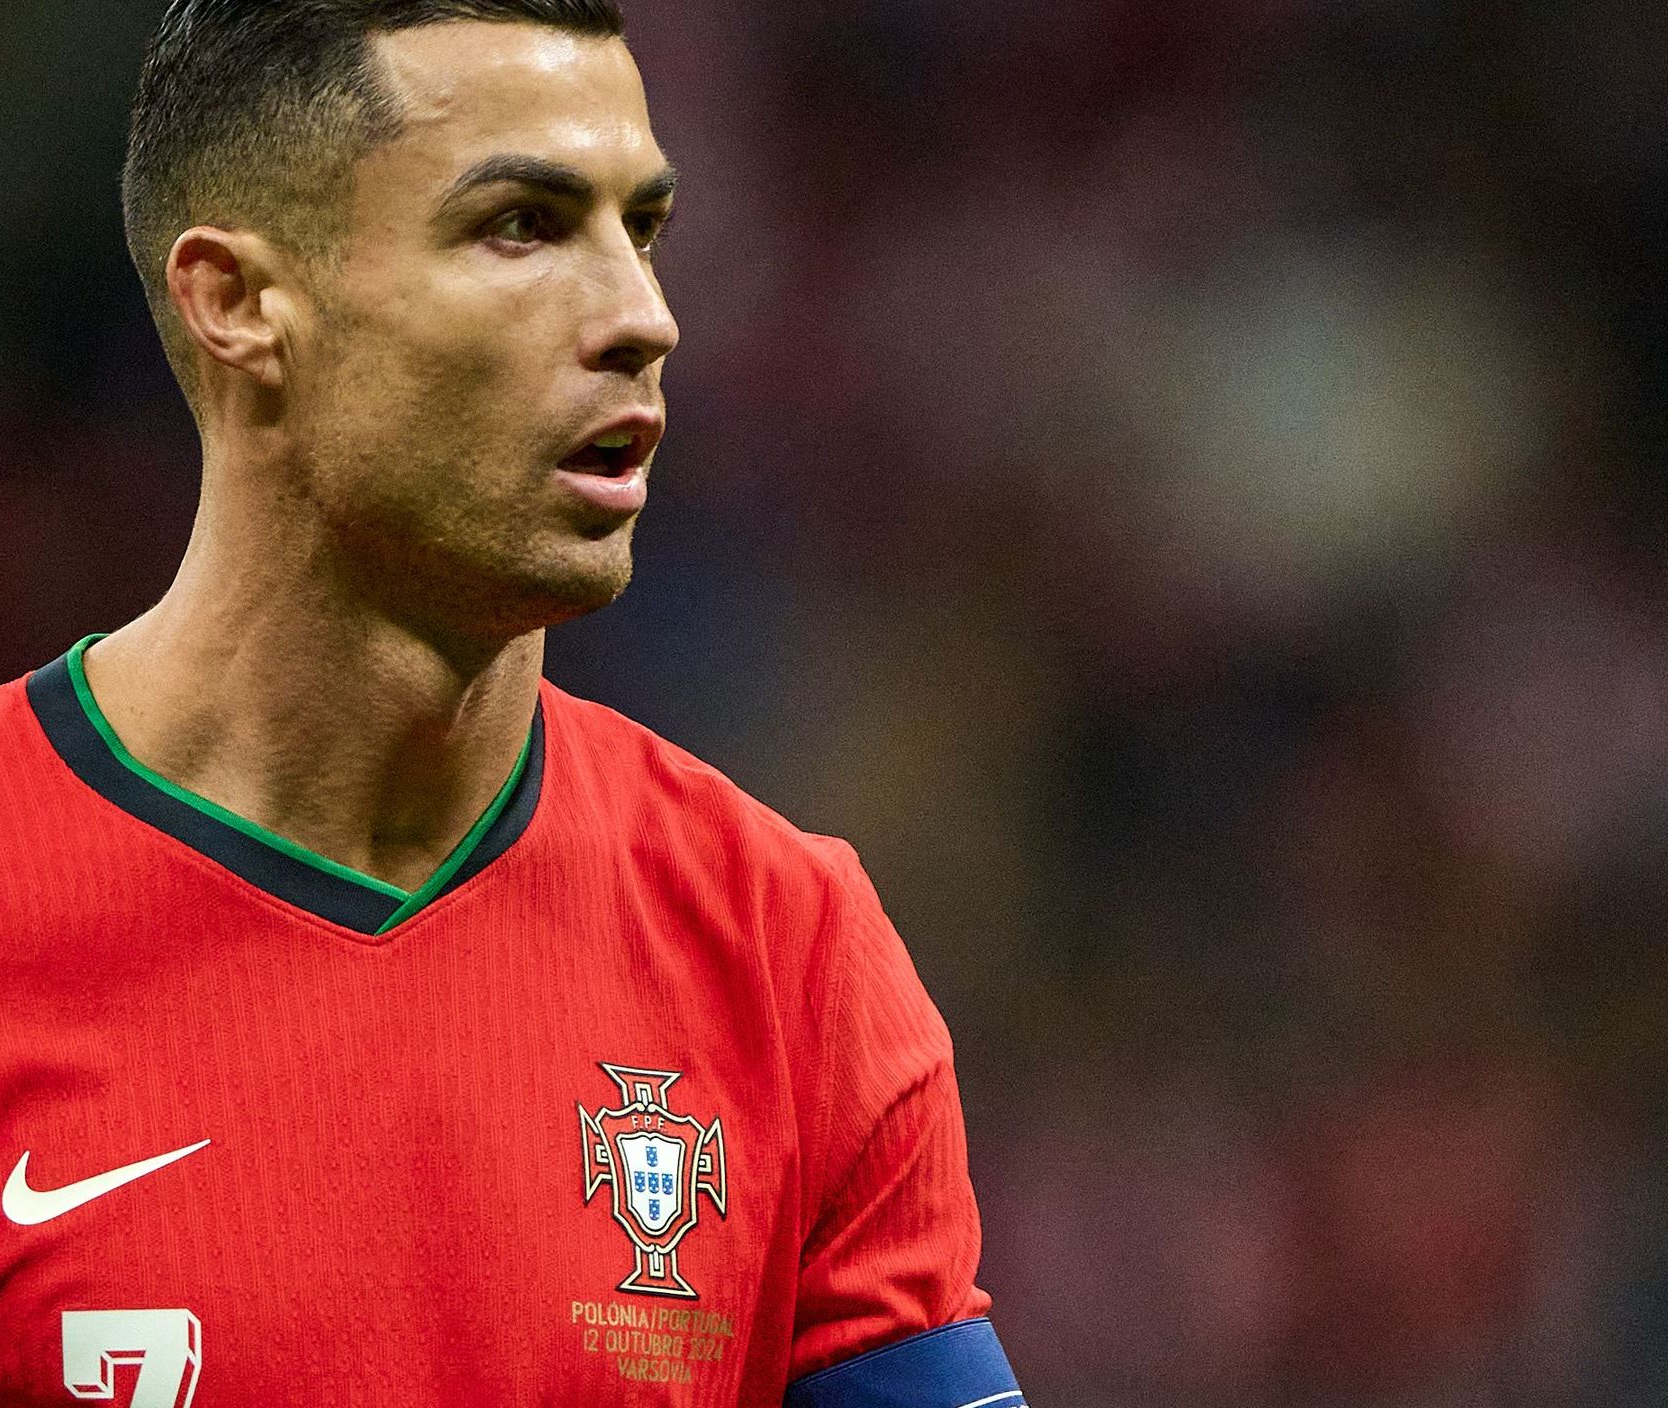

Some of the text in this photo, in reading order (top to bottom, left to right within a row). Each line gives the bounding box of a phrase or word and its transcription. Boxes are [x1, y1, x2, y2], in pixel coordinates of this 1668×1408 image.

[583, 1328, 723, 1361] 12 OUTUBRO 2024
